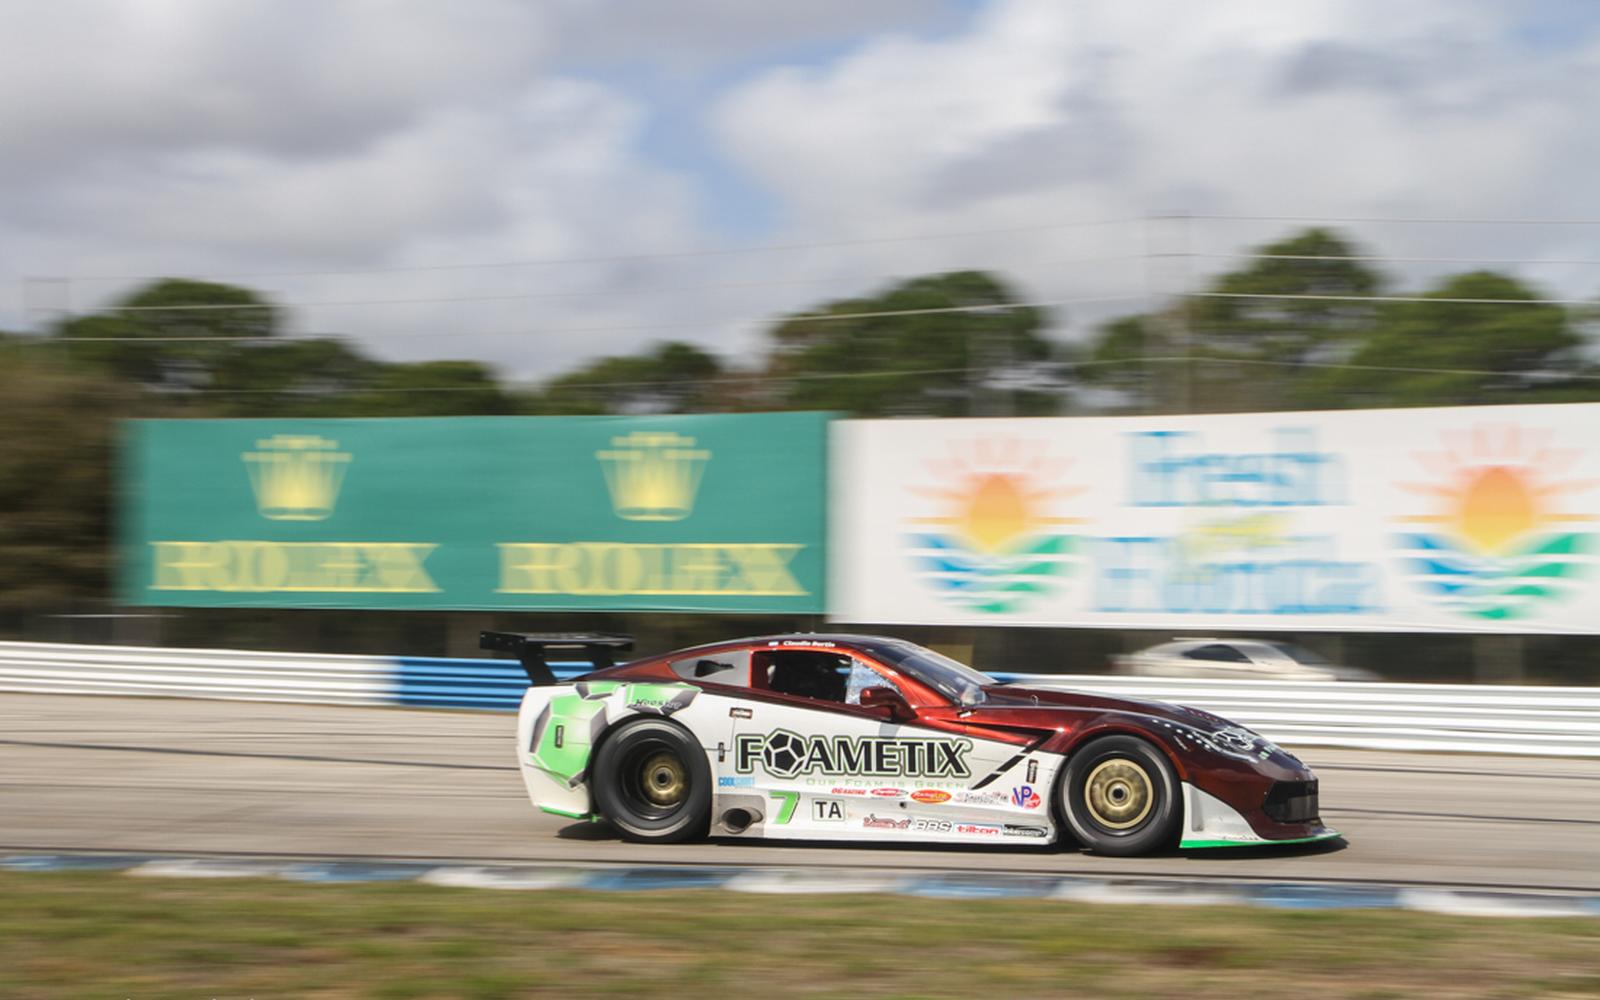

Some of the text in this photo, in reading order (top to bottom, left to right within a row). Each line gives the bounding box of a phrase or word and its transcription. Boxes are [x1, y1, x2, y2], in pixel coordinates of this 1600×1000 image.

[149, 541, 440, 592] ROLEX
[495, 541, 810, 597] ROLEX
[737, 729, 971, 777] FOAMETIX
[769, 790, 800, 825] 7
[814, 801, 843, 819] TA
[956, 824, 999, 835] tilton
